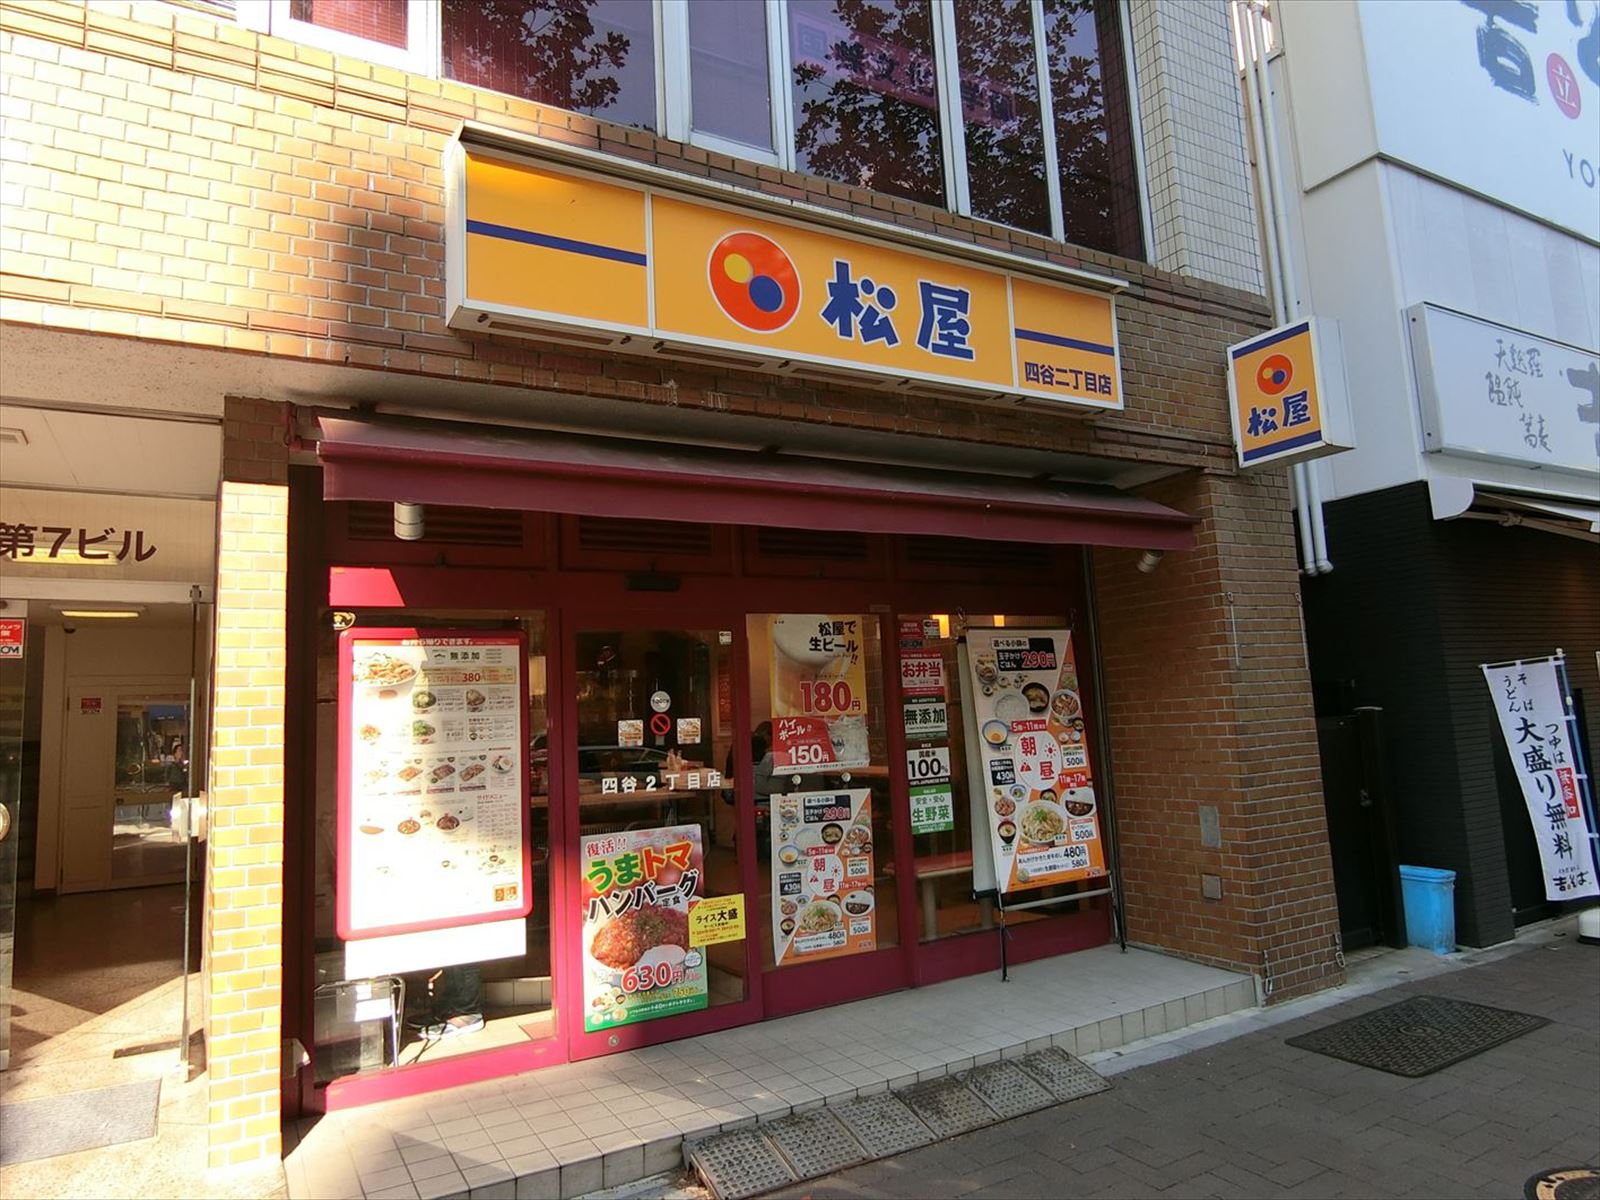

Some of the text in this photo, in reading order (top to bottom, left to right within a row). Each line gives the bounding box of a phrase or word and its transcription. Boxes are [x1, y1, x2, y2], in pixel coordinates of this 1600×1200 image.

[1562, 148, 1600, 189] YO
[820, 258, 976, 362] 松屋
[1023, 361, 1113, 397] 四谷二丁目店
[1247, 390, 1313, 438] 松屋
[818, 620, 857, 638] 松屋で
[902, 661, 942, 678] お弁当
[1503, 675, 1521, 713] うどん
[904, 708, 946, 726] 無添加
[1020, 736, 1037, 757] 朝
[1545, 723, 1566, 764] つゆは
[908, 758, 949, 778] 100%
[1515, 716, 1574, 860] 大盛り無料
[912, 805, 950, 824] 生野菜
[587, 840, 694, 893] うまトマ
[588, 869, 700, 922] ハンバーグ
[695, 907, 739, 925] ライス大盛
[620, 961, 685, 993] 630円
